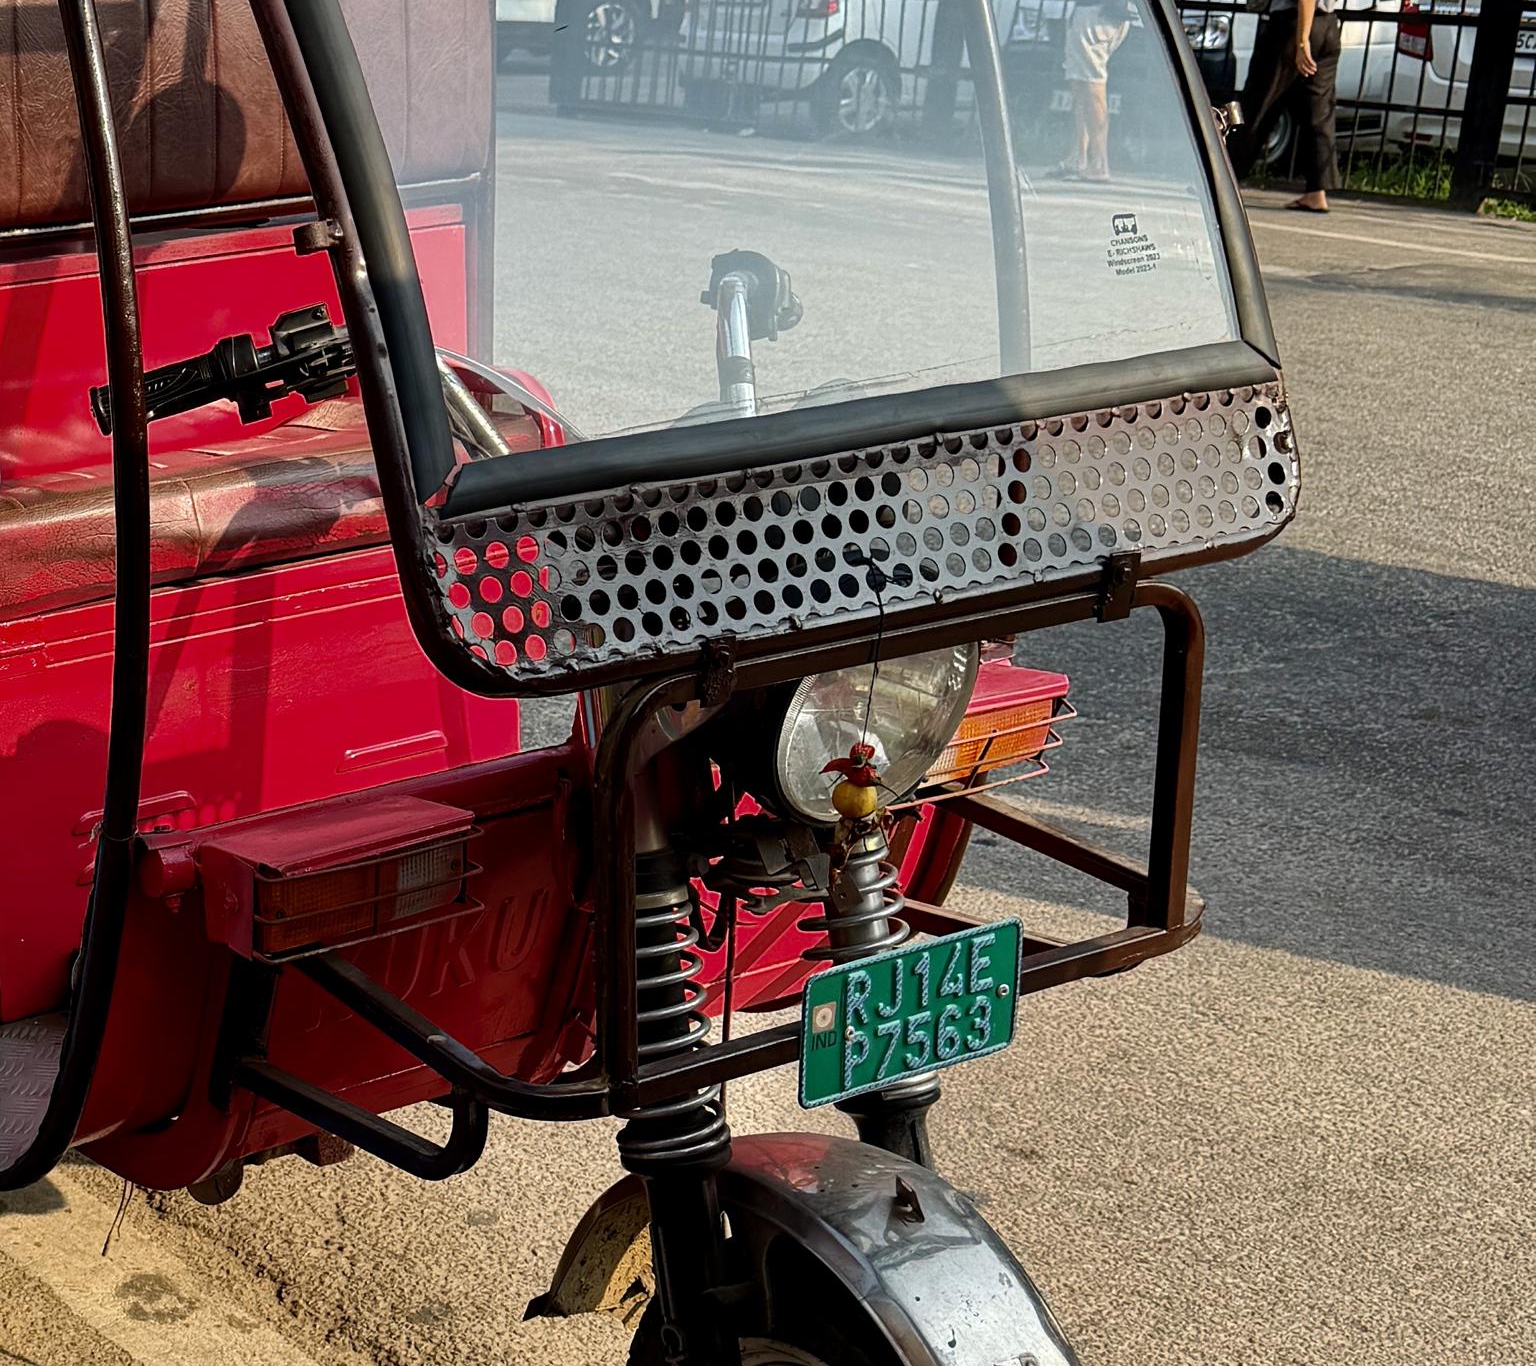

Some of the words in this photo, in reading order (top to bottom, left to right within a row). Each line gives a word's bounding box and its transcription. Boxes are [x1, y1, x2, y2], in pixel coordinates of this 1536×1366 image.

[847, 932, 996, 1025] RJ14E
[811, 1030, 837, 1051] IND
[844, 995, 992, 1091] P7563
